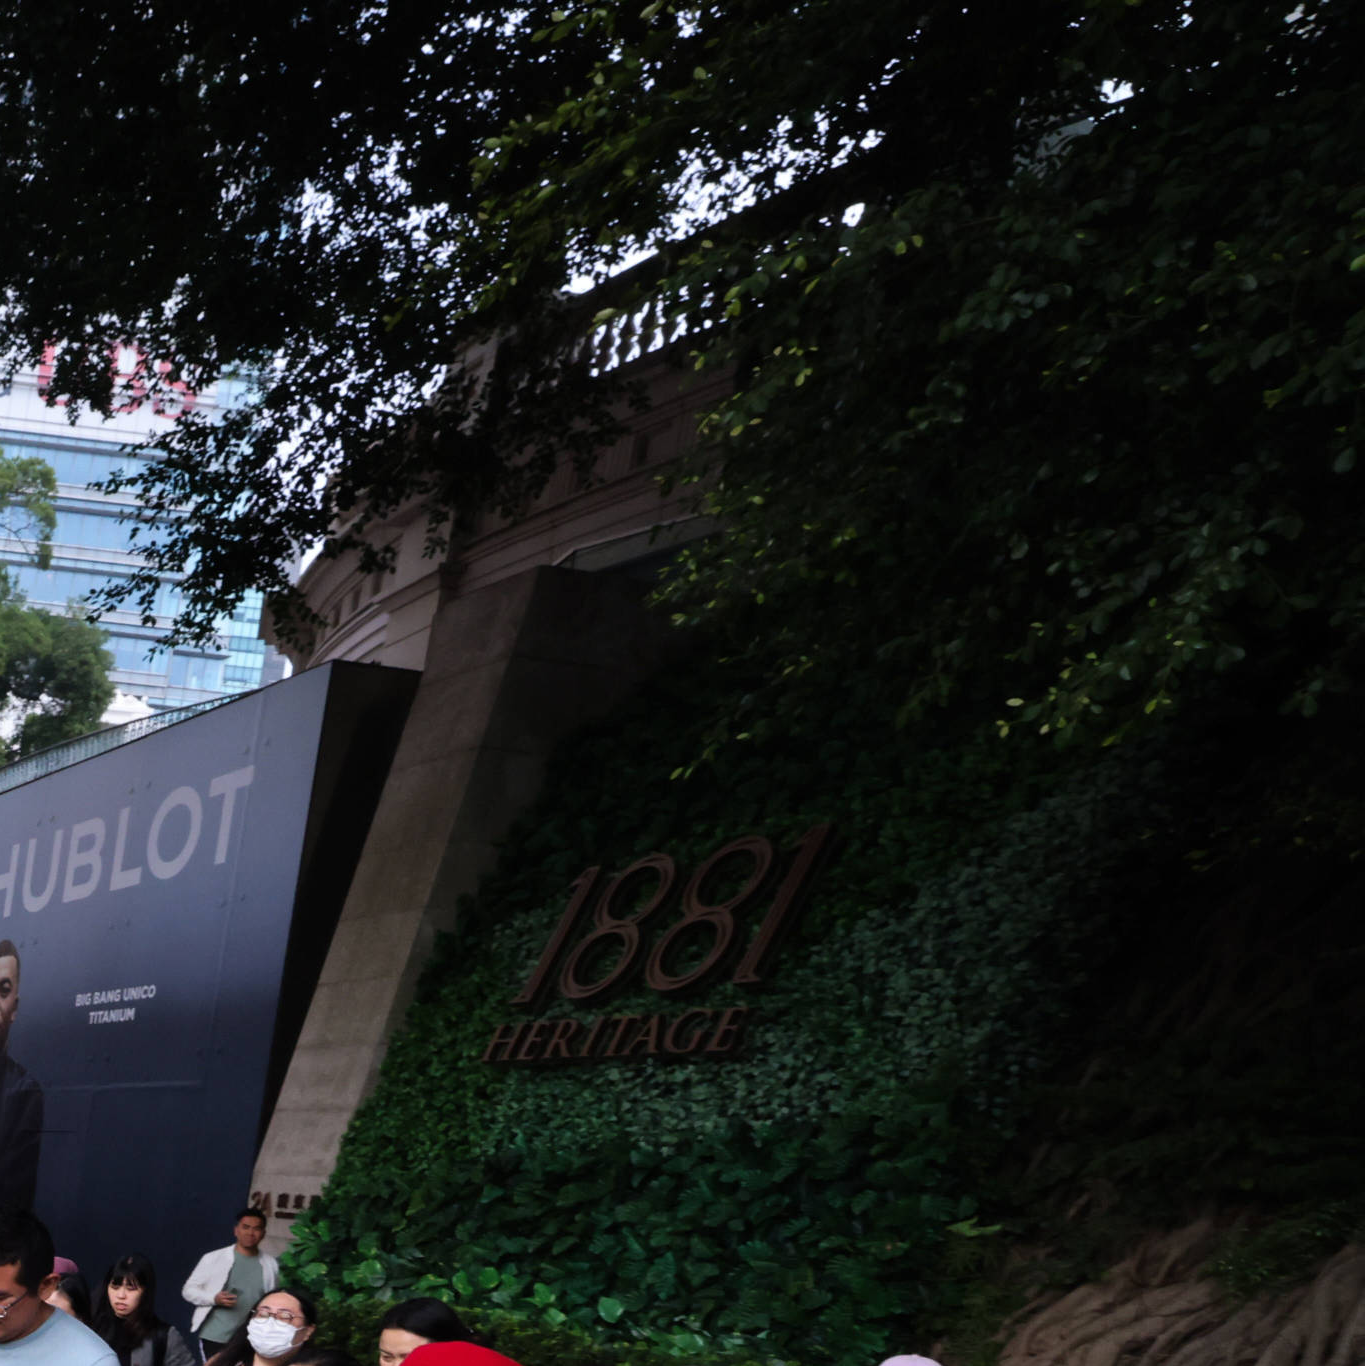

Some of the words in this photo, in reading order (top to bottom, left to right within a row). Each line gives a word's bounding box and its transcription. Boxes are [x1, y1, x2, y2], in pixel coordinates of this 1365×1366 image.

[508, 823, 831, 1004] 1881
[75, 993, 92, 1007] BIG
[93, 989, 121, 1005] BANG
[123, 984, 157, 1001] UNICO
[89, 1007, 136, 1025] TITANIUM
[481, 1006, 748, 1063] HERITAGE
